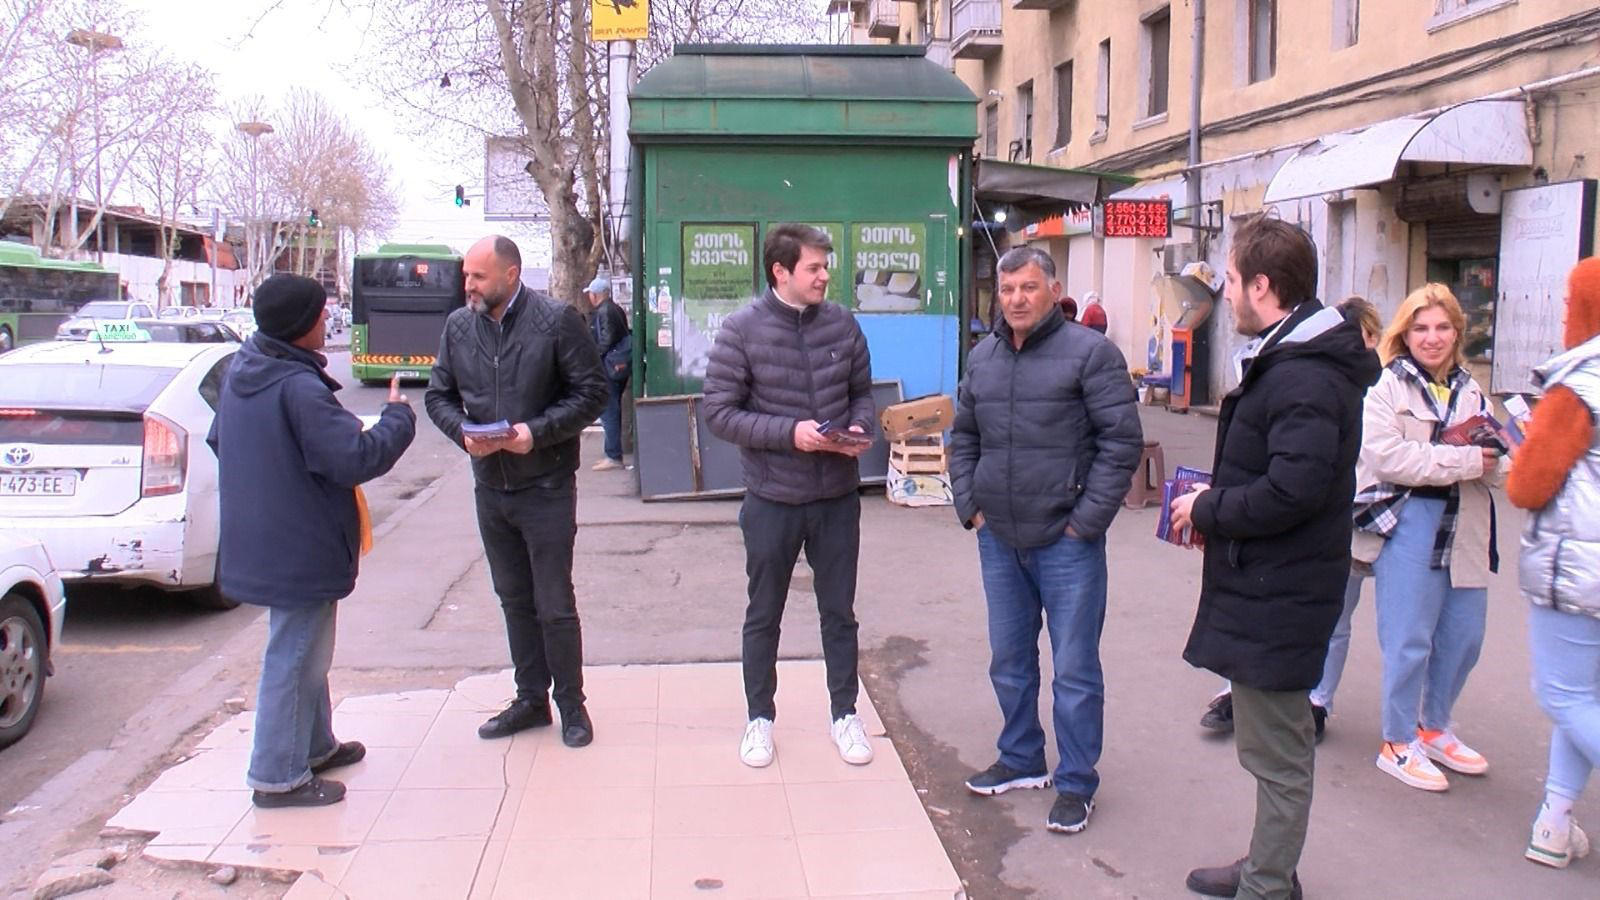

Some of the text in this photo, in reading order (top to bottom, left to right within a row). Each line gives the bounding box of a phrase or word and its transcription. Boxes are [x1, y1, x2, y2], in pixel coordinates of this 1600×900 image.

[690, 250, 748, 265] ყველი
[856, 252, 920, 270] ყველი
[104, 324, 129, 332] TAXI
